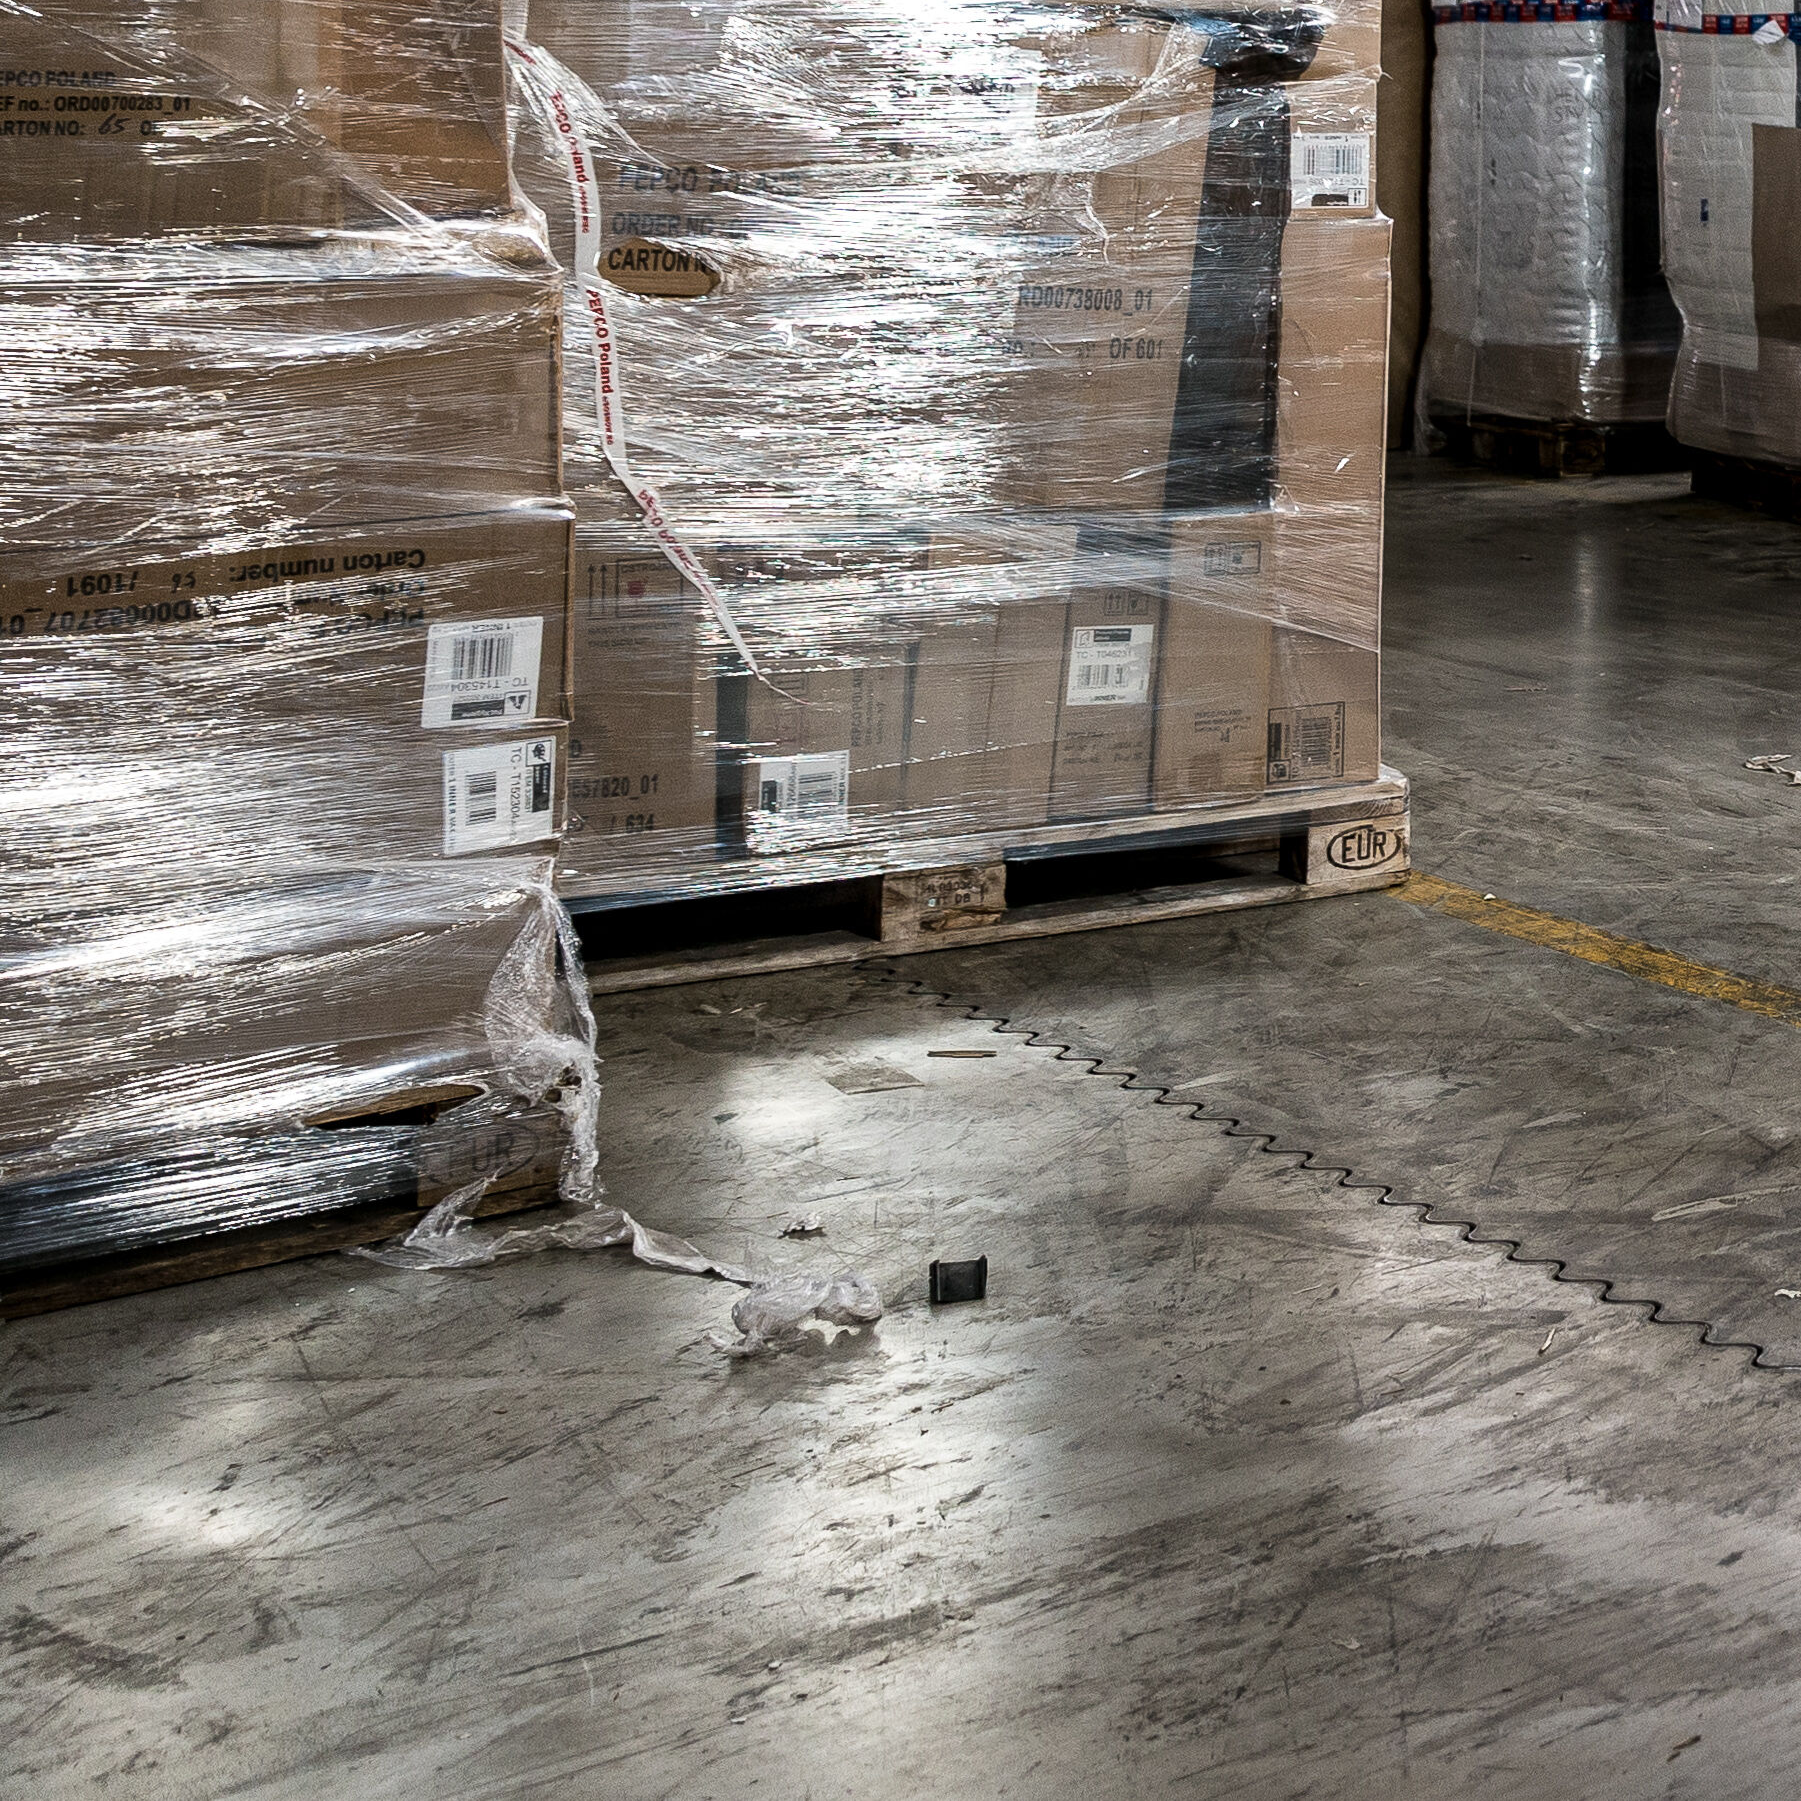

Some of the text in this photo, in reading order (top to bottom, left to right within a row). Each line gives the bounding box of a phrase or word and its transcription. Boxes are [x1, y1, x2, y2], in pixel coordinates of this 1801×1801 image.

[0, 96, 15, 112] EF
[612, 212, 682, 236] ORDER
[608, 248, 690, 274] CARTON
[1018, 285, 1153, 316] RD00738008_01
[1109, 337, 1133, 360] OF
[597, 342, 614, 395] Poland
[229, 557, 336, 584] number:
[344, 548, 427, 572] Carton
[1076, 650, 1089, 660] TC
[511, 676, 529, 689] TC
[510, 746, 523, 765] TC
[508, 772, 522, 824] T152304
[1341, 827, 1387, 864] EUR
